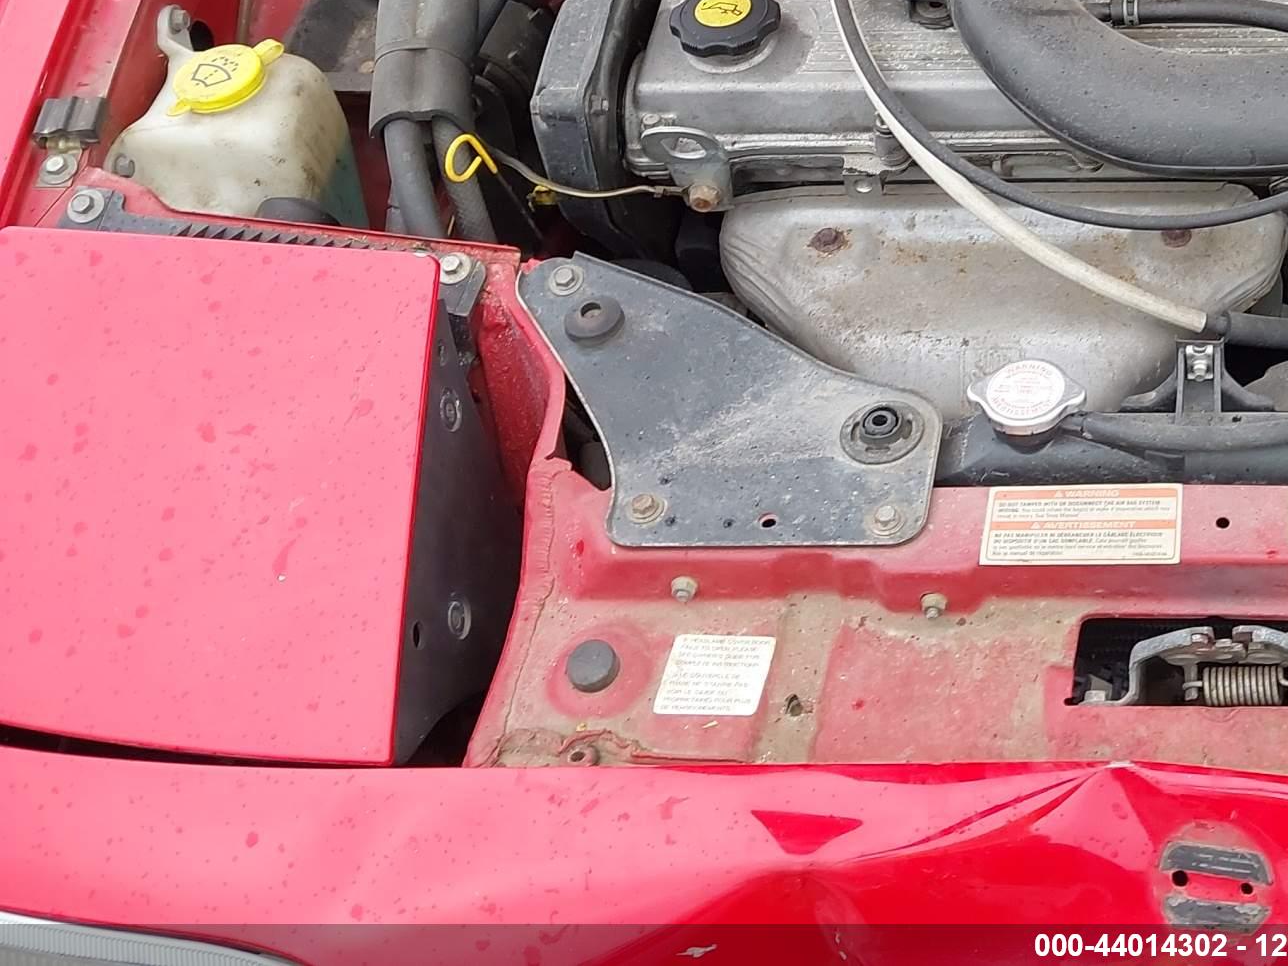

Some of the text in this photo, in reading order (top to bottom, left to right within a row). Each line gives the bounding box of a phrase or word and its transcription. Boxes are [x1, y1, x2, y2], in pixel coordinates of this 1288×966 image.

[1007, 363, 1053, 377] WARNING
[1065, 490, 1120, 498] WARNING
[1043, 521, 1136, 529] AVERTISSEMENT
